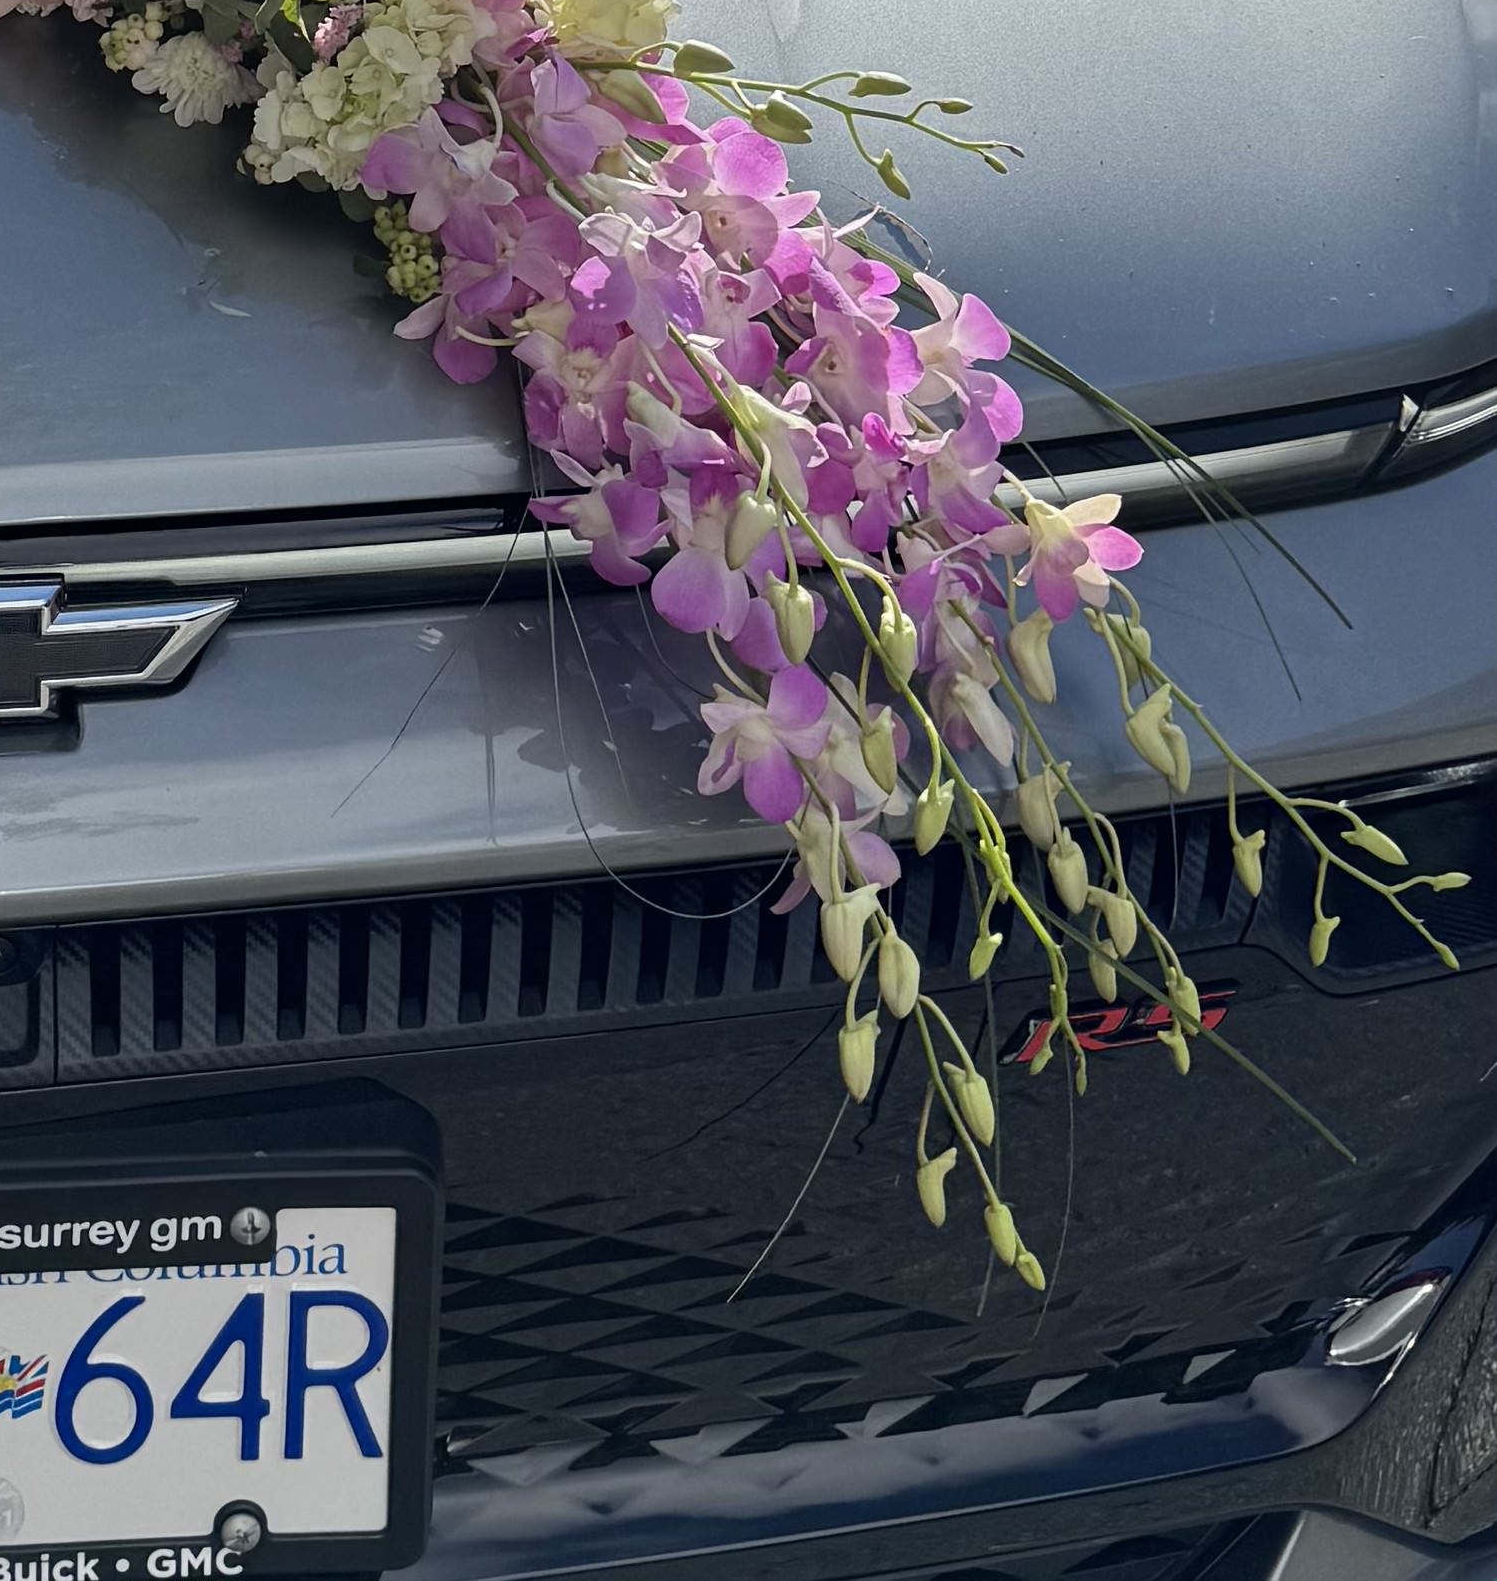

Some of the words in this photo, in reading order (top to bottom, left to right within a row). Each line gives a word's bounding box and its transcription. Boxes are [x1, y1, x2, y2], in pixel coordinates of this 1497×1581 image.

[149, 1215, 223, 1252] gm
[55, 1289, 390, 1466] 64R
[146, 1546, 244, 1579] GMC
